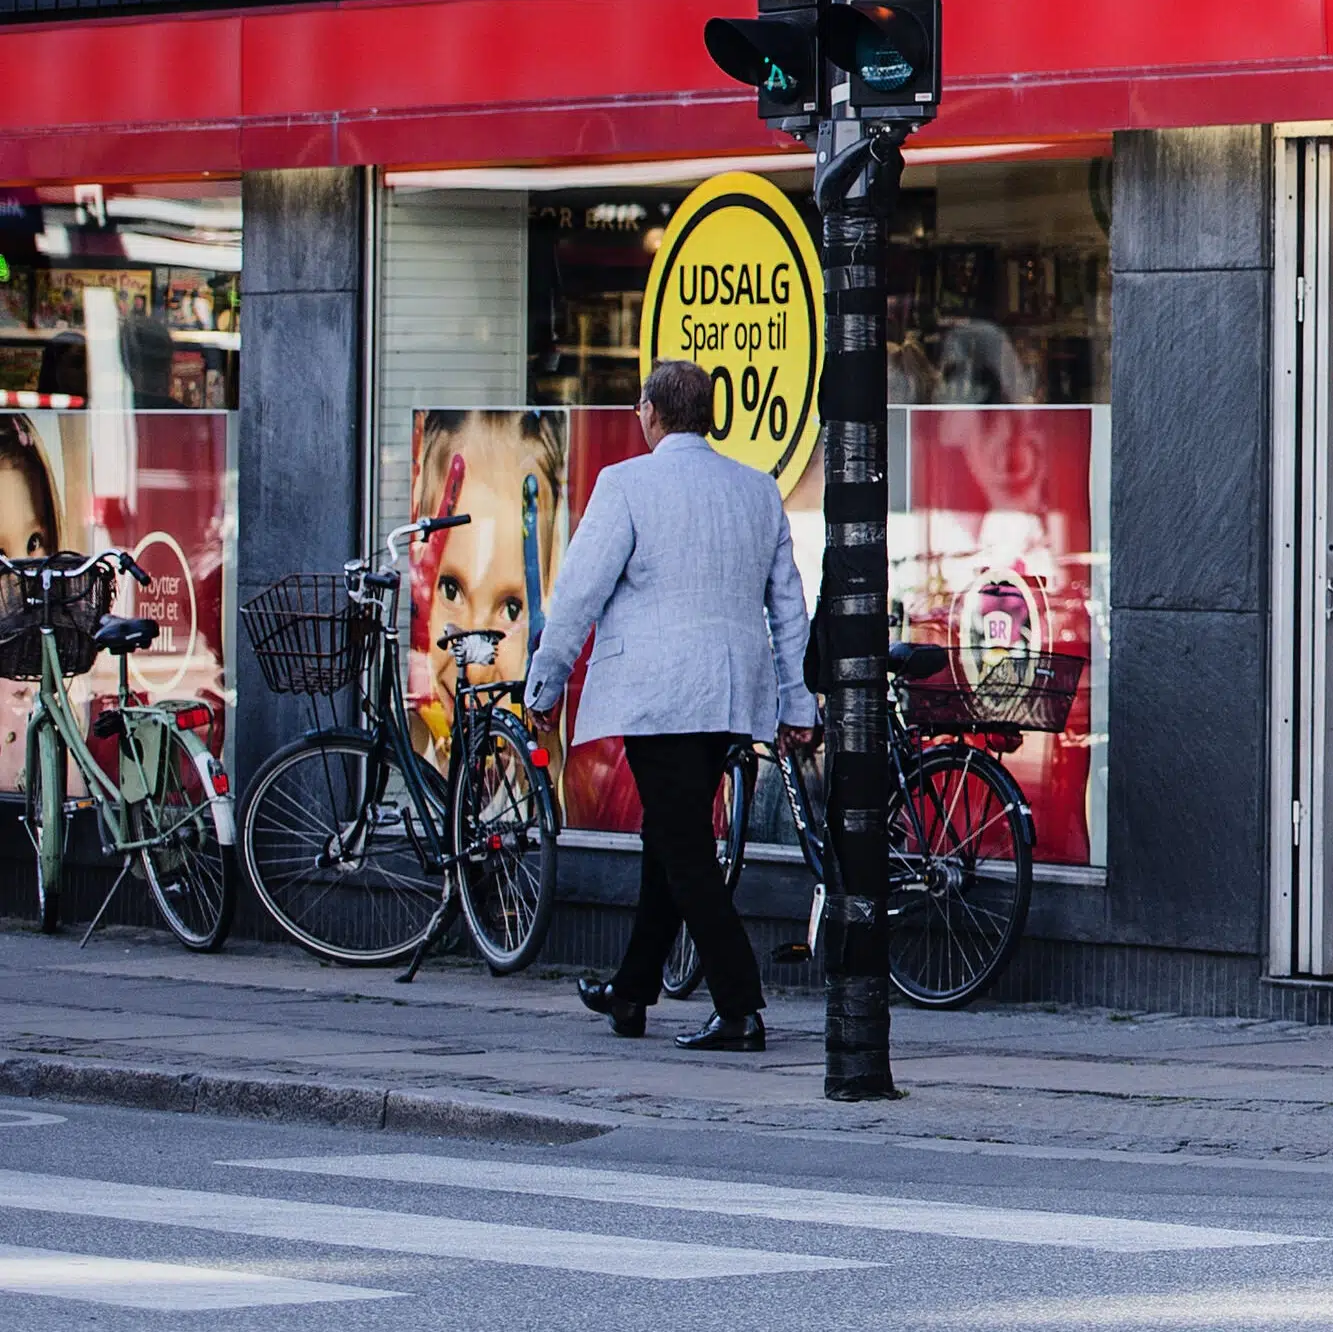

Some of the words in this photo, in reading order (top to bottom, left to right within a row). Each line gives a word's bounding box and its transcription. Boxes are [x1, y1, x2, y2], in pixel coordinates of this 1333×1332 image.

[679, 263, 790, 305] UDSALG
[681, 315, 729, 362] Spar
[734, 321, 761, 362] op
[768, 311, 787, 350] til
[708, 366, 788, 441] 0%
[139, 598, 165, 620] med
[167, 601, 178, 621] et
[150, 626, 177, 652] MIL
[988, 620, 1007, 640] BR
